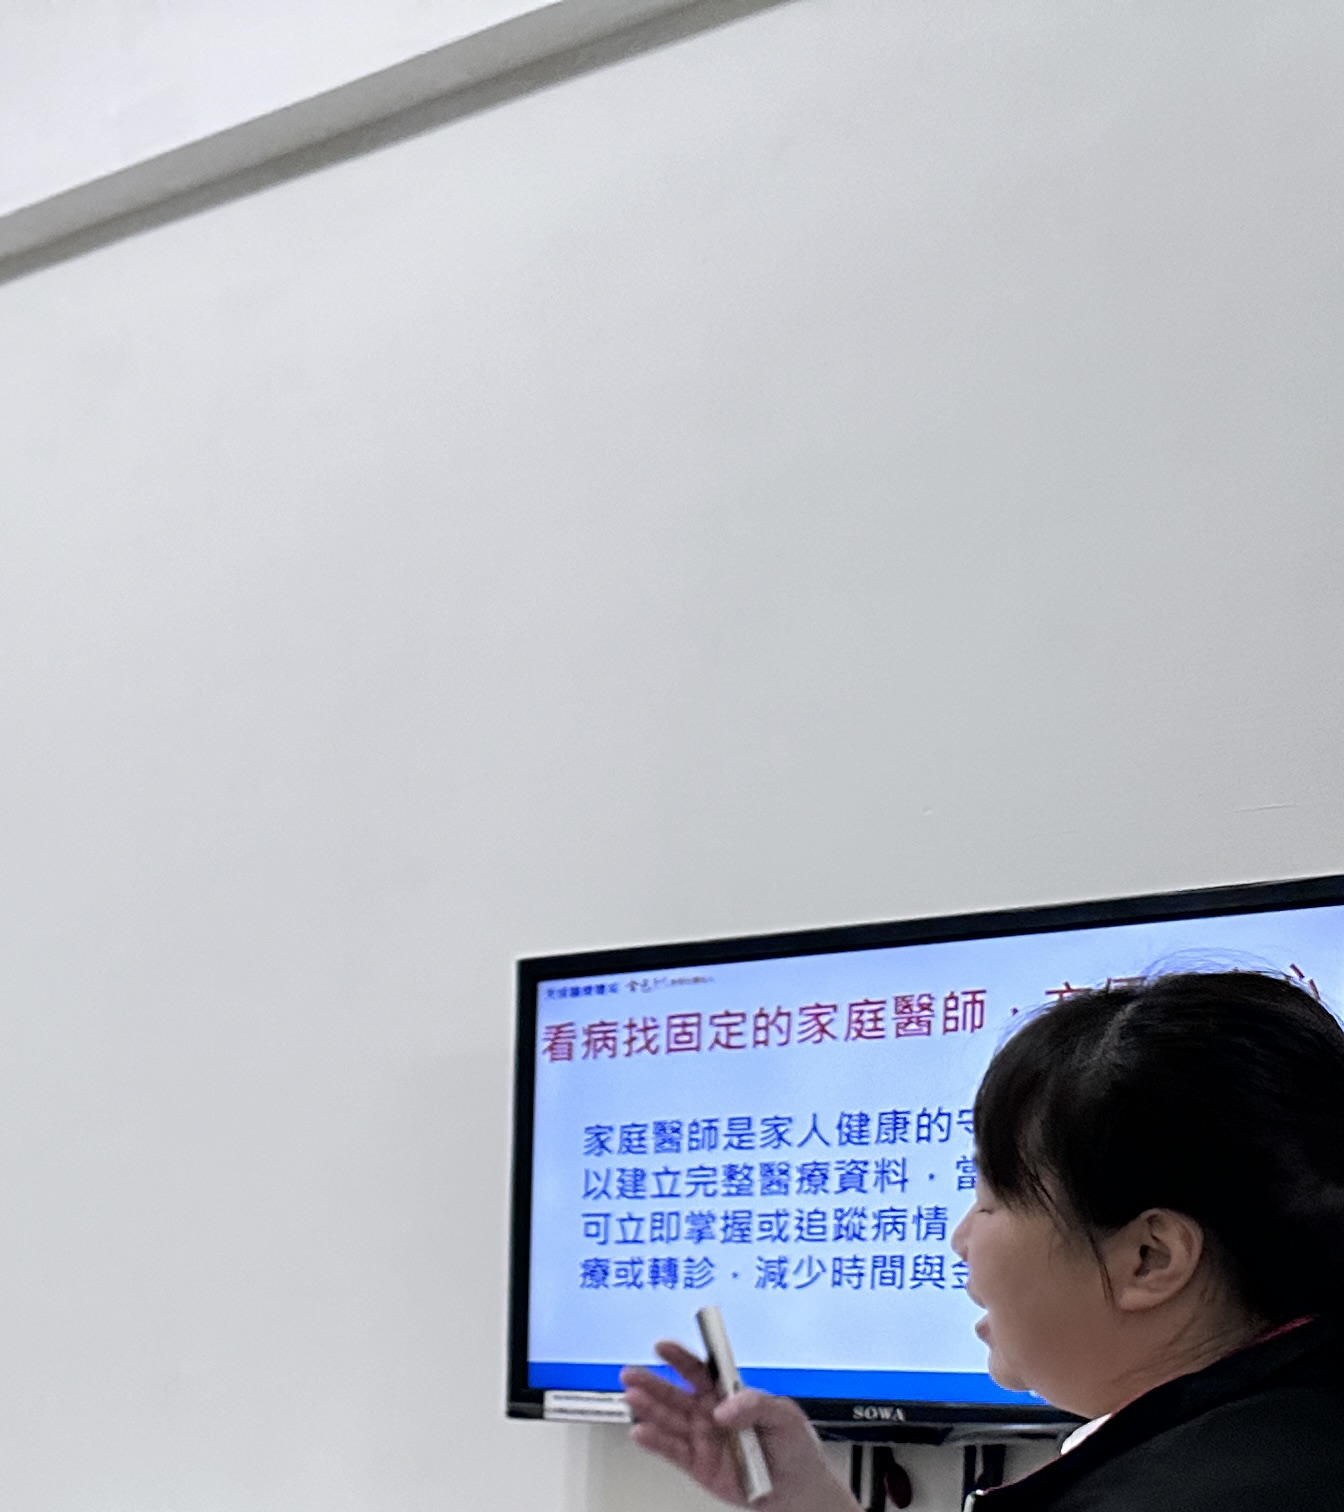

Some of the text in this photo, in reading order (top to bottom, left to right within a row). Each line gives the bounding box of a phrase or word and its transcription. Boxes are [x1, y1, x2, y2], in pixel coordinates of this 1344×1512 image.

[581, 1204, 948, 1246] 可立即掌握或追蹤病情
[852, 1405, 906, 1423] SOWA
